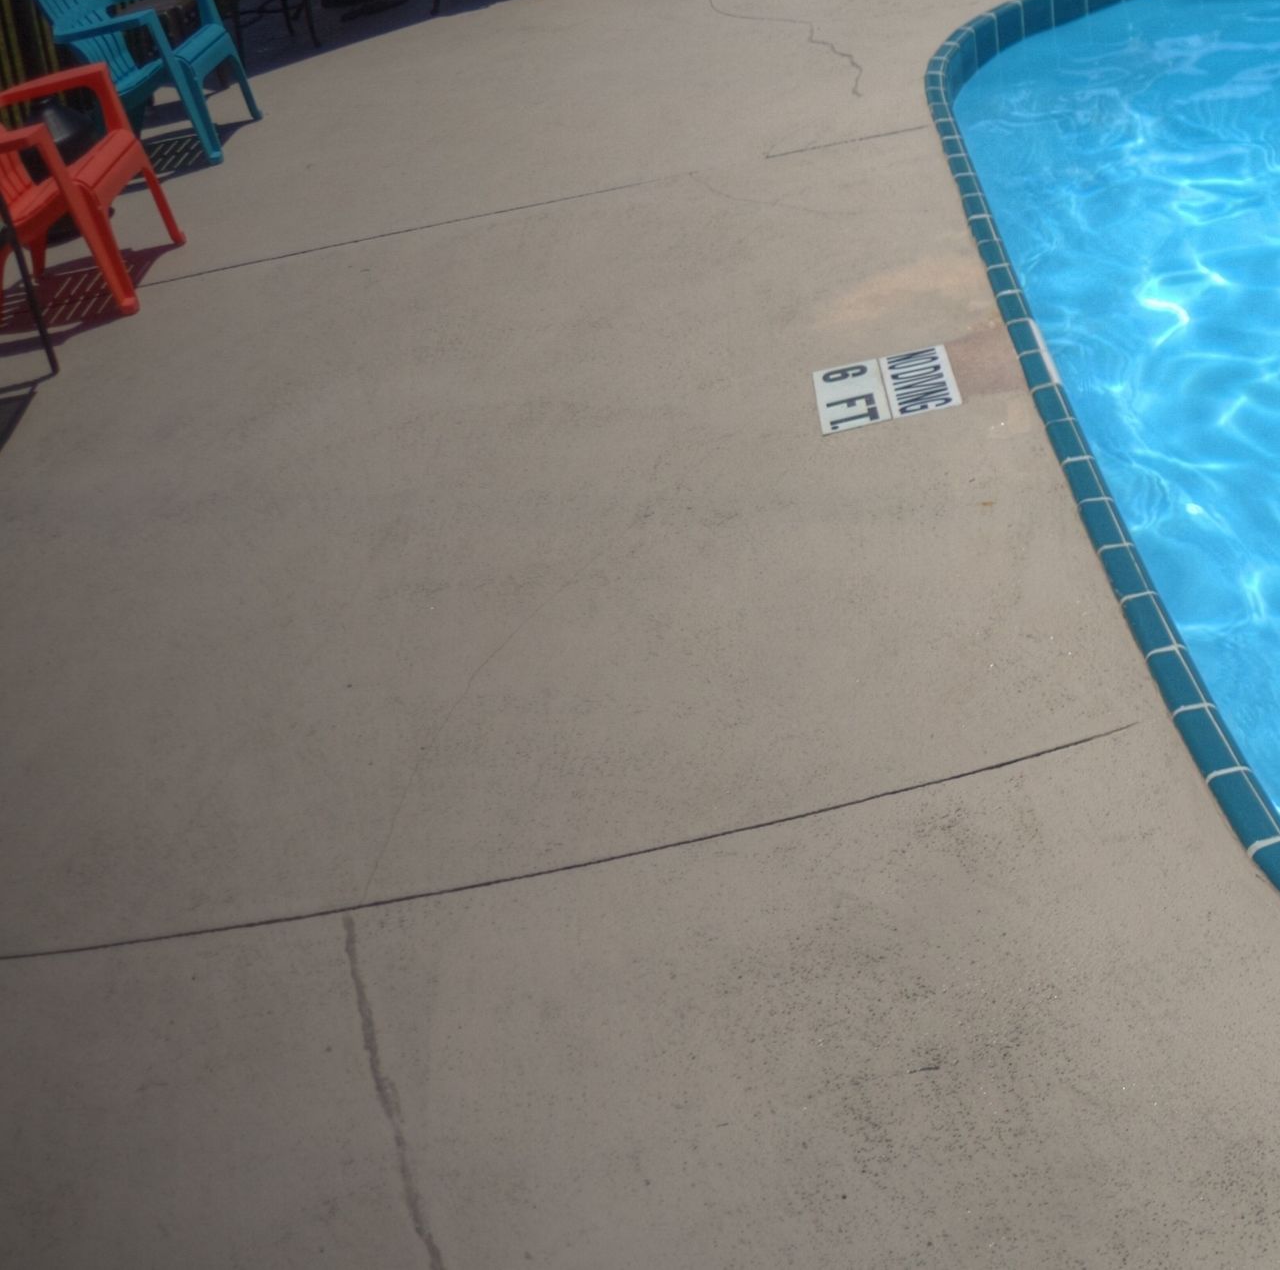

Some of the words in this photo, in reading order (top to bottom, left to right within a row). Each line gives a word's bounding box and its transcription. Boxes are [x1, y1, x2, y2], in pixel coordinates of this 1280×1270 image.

[886, 347, 939, 371] NO
[822, 364, 868, 383] 6
[890, 364, 953, 415] DIVING
